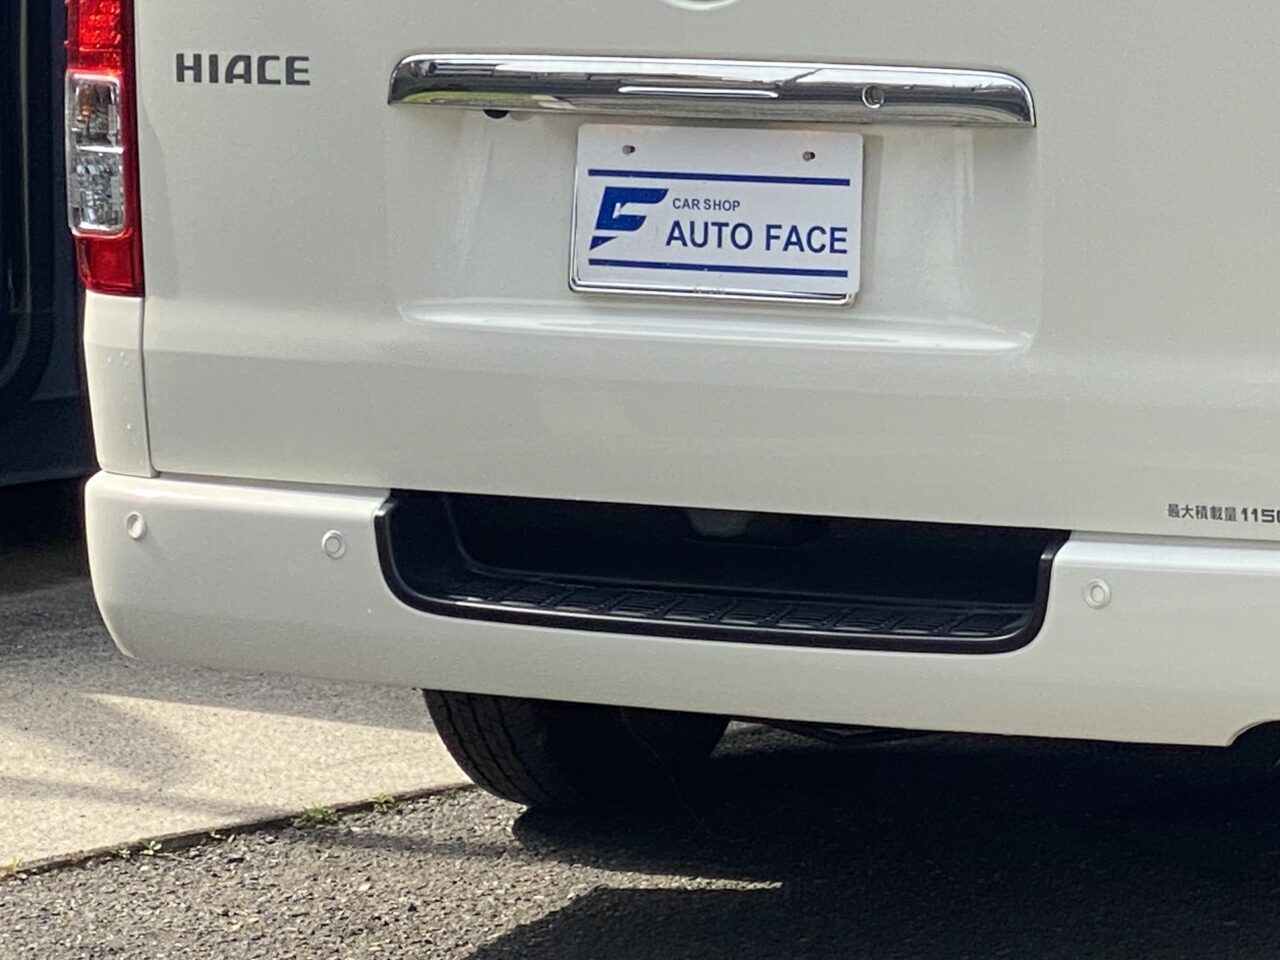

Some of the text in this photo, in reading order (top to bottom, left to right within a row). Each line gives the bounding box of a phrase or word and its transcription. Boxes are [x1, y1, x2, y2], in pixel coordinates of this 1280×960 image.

[176, 53, 310, 85] HIACE
[672, 197, 741, 212] CAR SHOP
[665, 219, 848, 255] AUTO FACE
